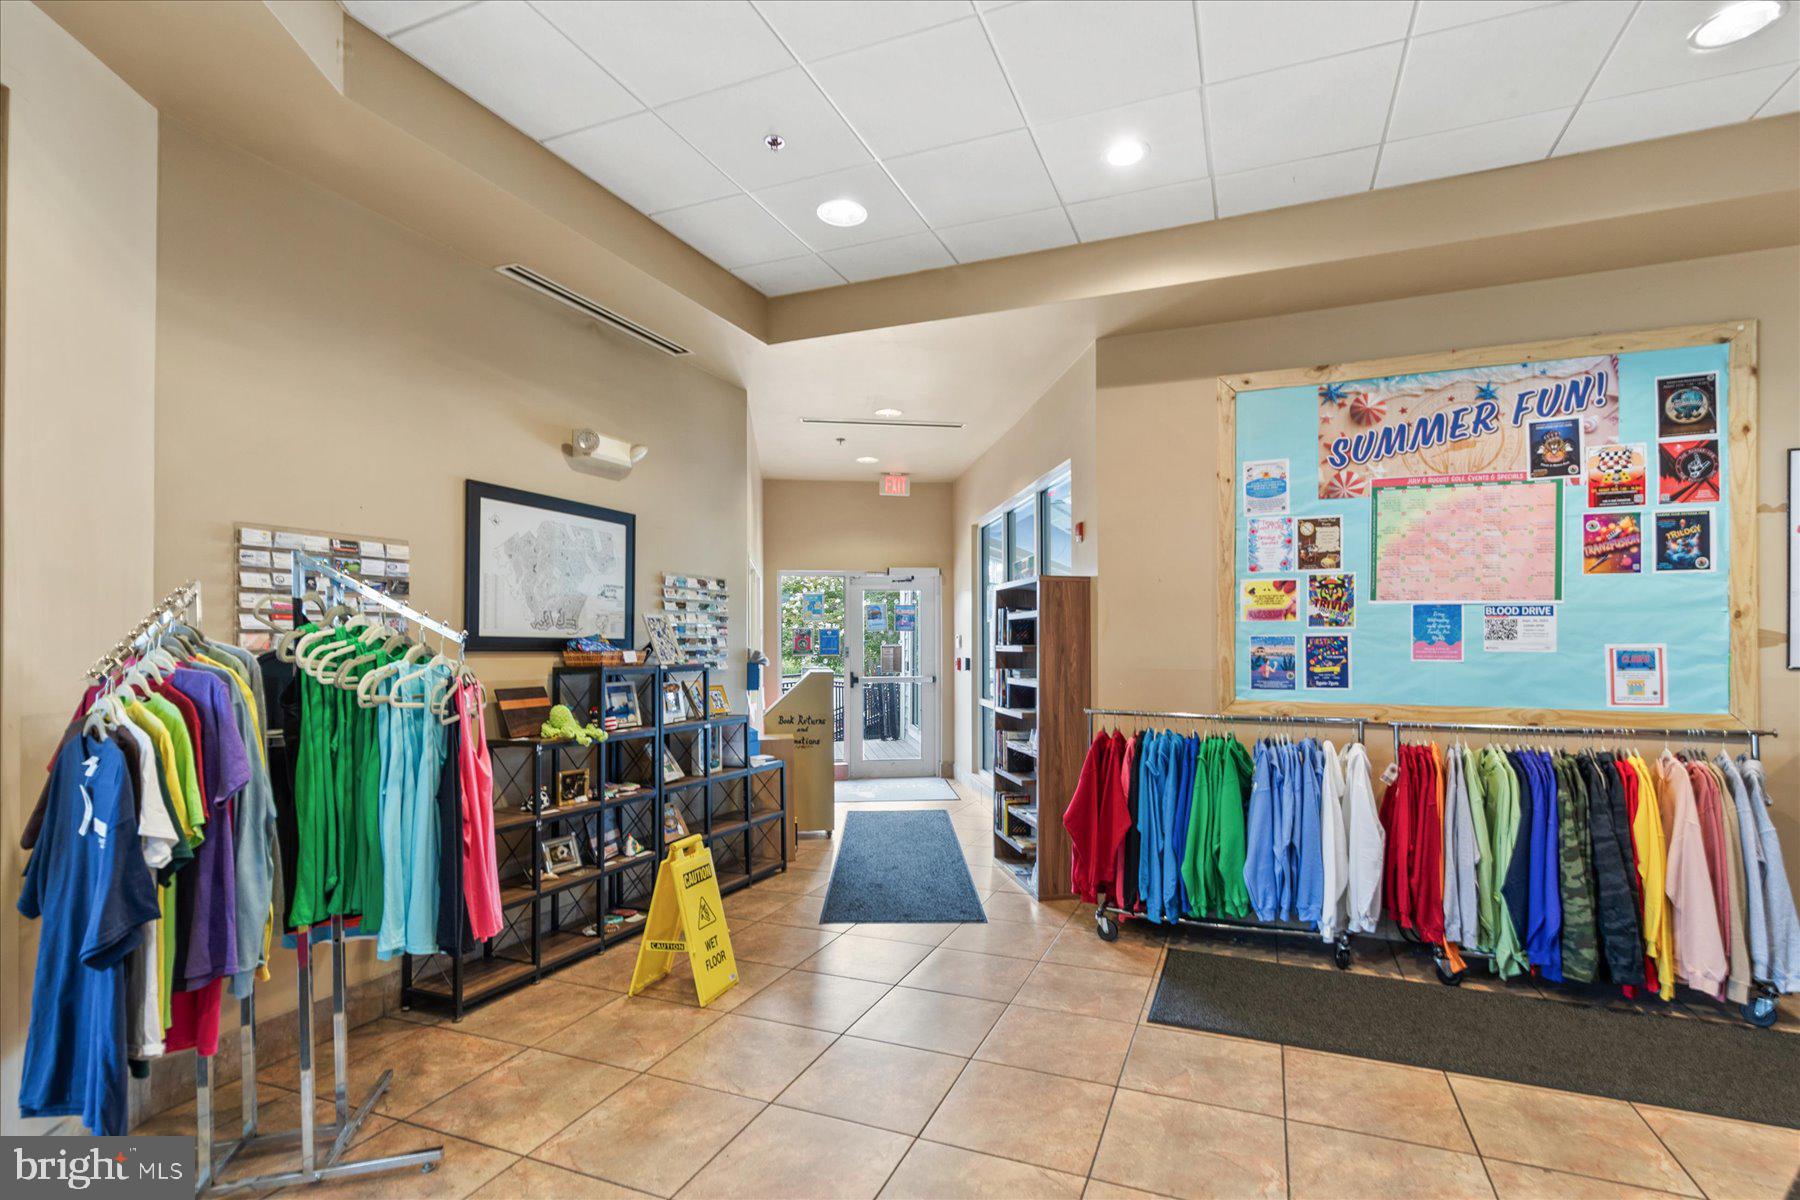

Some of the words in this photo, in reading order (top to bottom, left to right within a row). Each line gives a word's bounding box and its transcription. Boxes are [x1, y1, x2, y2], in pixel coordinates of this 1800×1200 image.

[1327, 401, 1499, 469] SUMMER
[1511, 371, 1607, 427] FUN!
[885, 475, 906, 495] EXIT
[1427, 476, 1449, 484] AUGUST
[1468, 474, 1489, 482] EVENTS
[1497, 472, 1524, 480] SPECIALS
[1665, 524, 1702, 540] TRILOGY
[1313, 598, 1349, 612] TRIVIA
[1485, 605, 1520, 616] BLOOD
[1521, 605, 1552, 616] DRIVE
[778, 715, 795, 725] Book
[797, 714, 827, 726] Returns
[684, 863, 713, 889] CAUTION
[650, 942, 685, 951] CAUTION
[704, 934, 719, 951] WET
[705, 950, 727, 972] FLOOR
